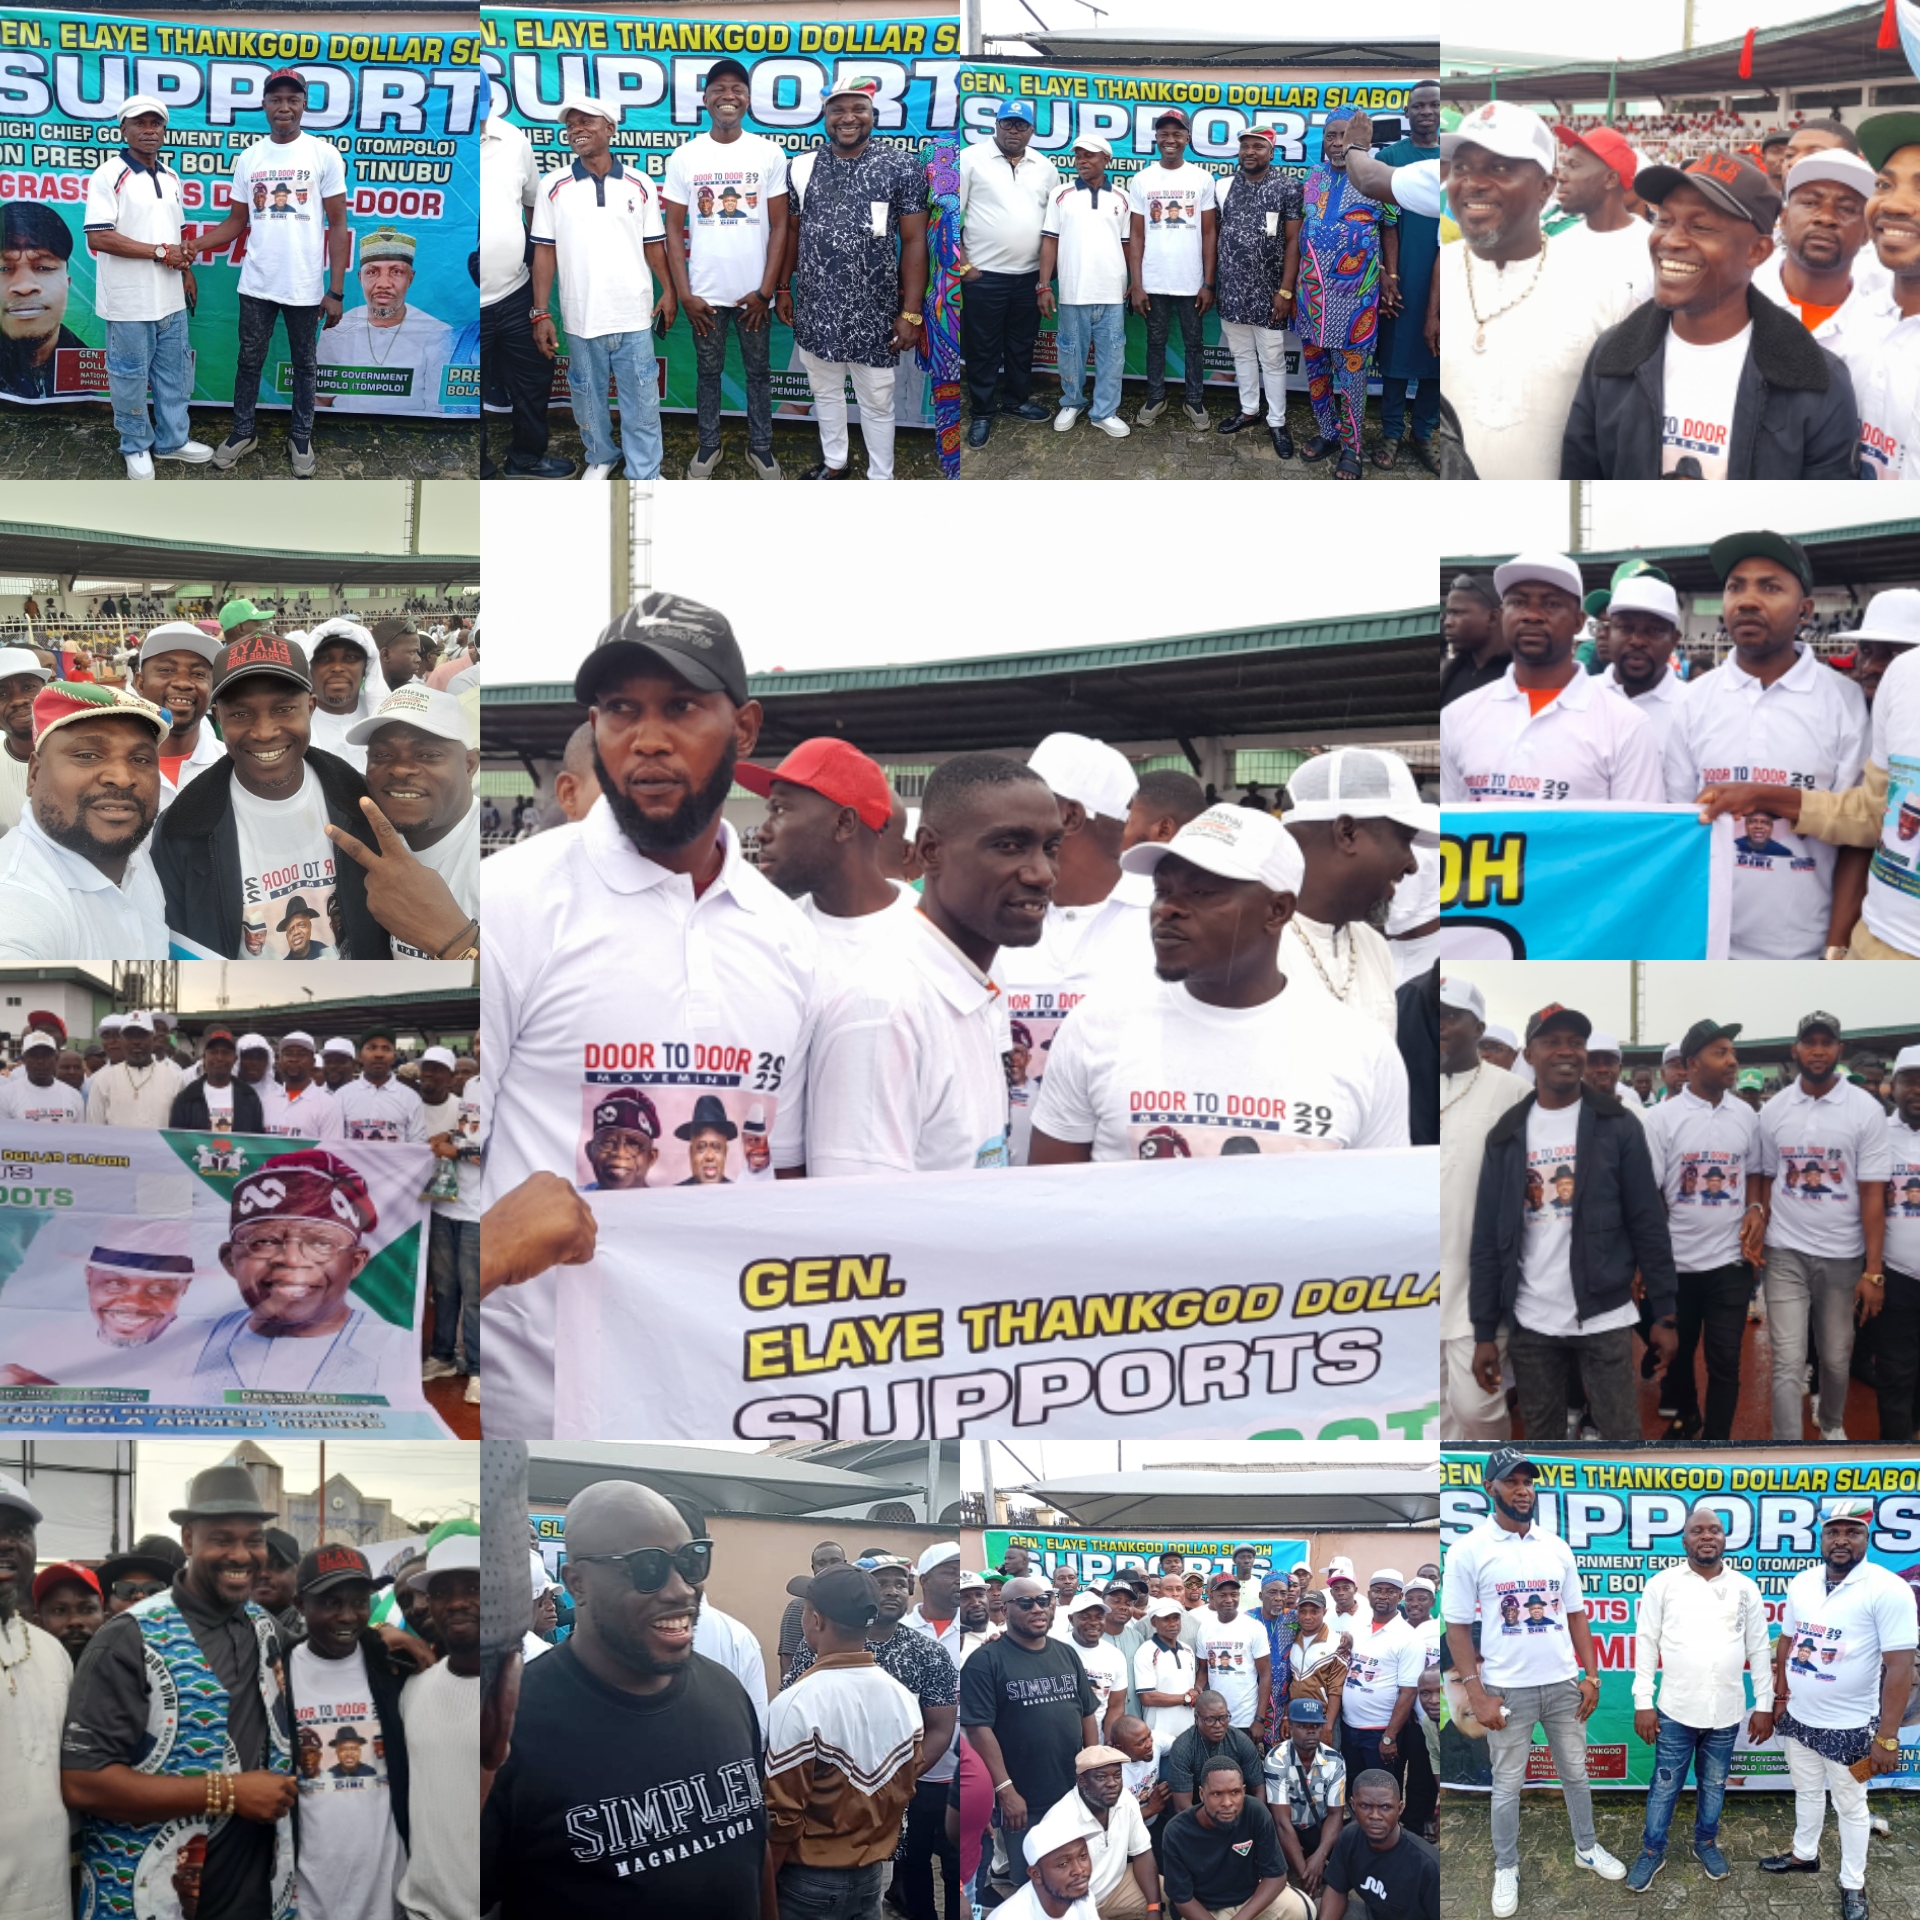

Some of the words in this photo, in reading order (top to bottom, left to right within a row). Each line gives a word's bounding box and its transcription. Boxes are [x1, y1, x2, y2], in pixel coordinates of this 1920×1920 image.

[60, 22, 148, 52] ELAYE
[156, 27, 320, 60] THANKGOD
[328, 34, 444, 64] DOLLAR
[514, 20, 607, 50] ELAYE
[614, 22, 791, 53] THANKGOD
[799, 25, 926, 54] DOLLAR
[960, 72, 1012, 93] GEN.
[1020, 75, 1088, 97] ELAYE
[1094, 79, 1220, 104] THANKGOD
[1228, 83, 1318, 108] DOLLAR
[40, 124, 92, 142] CHIEF
[356, 138, 456, 157] (TOMPOLO)
[355, 160, 451, 183] TINUBU
[714, 172, 723, 180] TO
[724, 172, 744, 180] DOOR
[316, 368, 338, 377] HIEF
[341, 370, 409, 382] GOVERNMENT
[351, 382, 404, 393] (TOMPOLO)
[1682, 418, 1727, 446] DOOR
[1491, 772, 1506, 787] TO
[1544, 779, 1570, 791] 20
[1733, 766, 1749, 781] TO
[1752, 767, 1788, 785] DOOR
[1790, 772, 1816, 785] 20
[1036, 993, 1054, 1009] TO
[584, 1042, 655, 1070] DOOR
[662, 1042, 689, 1069] TO
[694, 1044, 752, 1075] DOOR
[752, 1072, 782, 1092] 27
[1130, 1091, 1186, 1112] DOOR
[1193, 1093, 1219, 1113] TO
[1227, 1095, 1286, 1119] DOOR
[1293, 1102, 1332, 1120] 20
[1139, 1115, 1268, 1130] MOVEMENT
[1293, 1118, 1332, 1137] 27
[2, 1150, 65, 1164] DOLLAR
[67, 1152, 130, 1168] SLABOH
[740, 1254, 906, 1311] GEN.
[743, 1309, 943, 1382] ELAYE
[961, 1283, 1283, 1353] THANKGOD
[733, 1327, 1383, 1440] SUPPORTS
[1583, 1465, 1724, 1490] THANKGOD
[1731, 1469, 1829, 1492] DOLLAR
[1046, 1537, 1088, 1551] ELAYE
[1090, 1540, 1165, 1554] THANKGOD
[1167, 1543, 1218, 1556] DOLLAR
[1527, 1580, 1547, 1588] DOOR
[319, 1704, 333, 1716] TO
